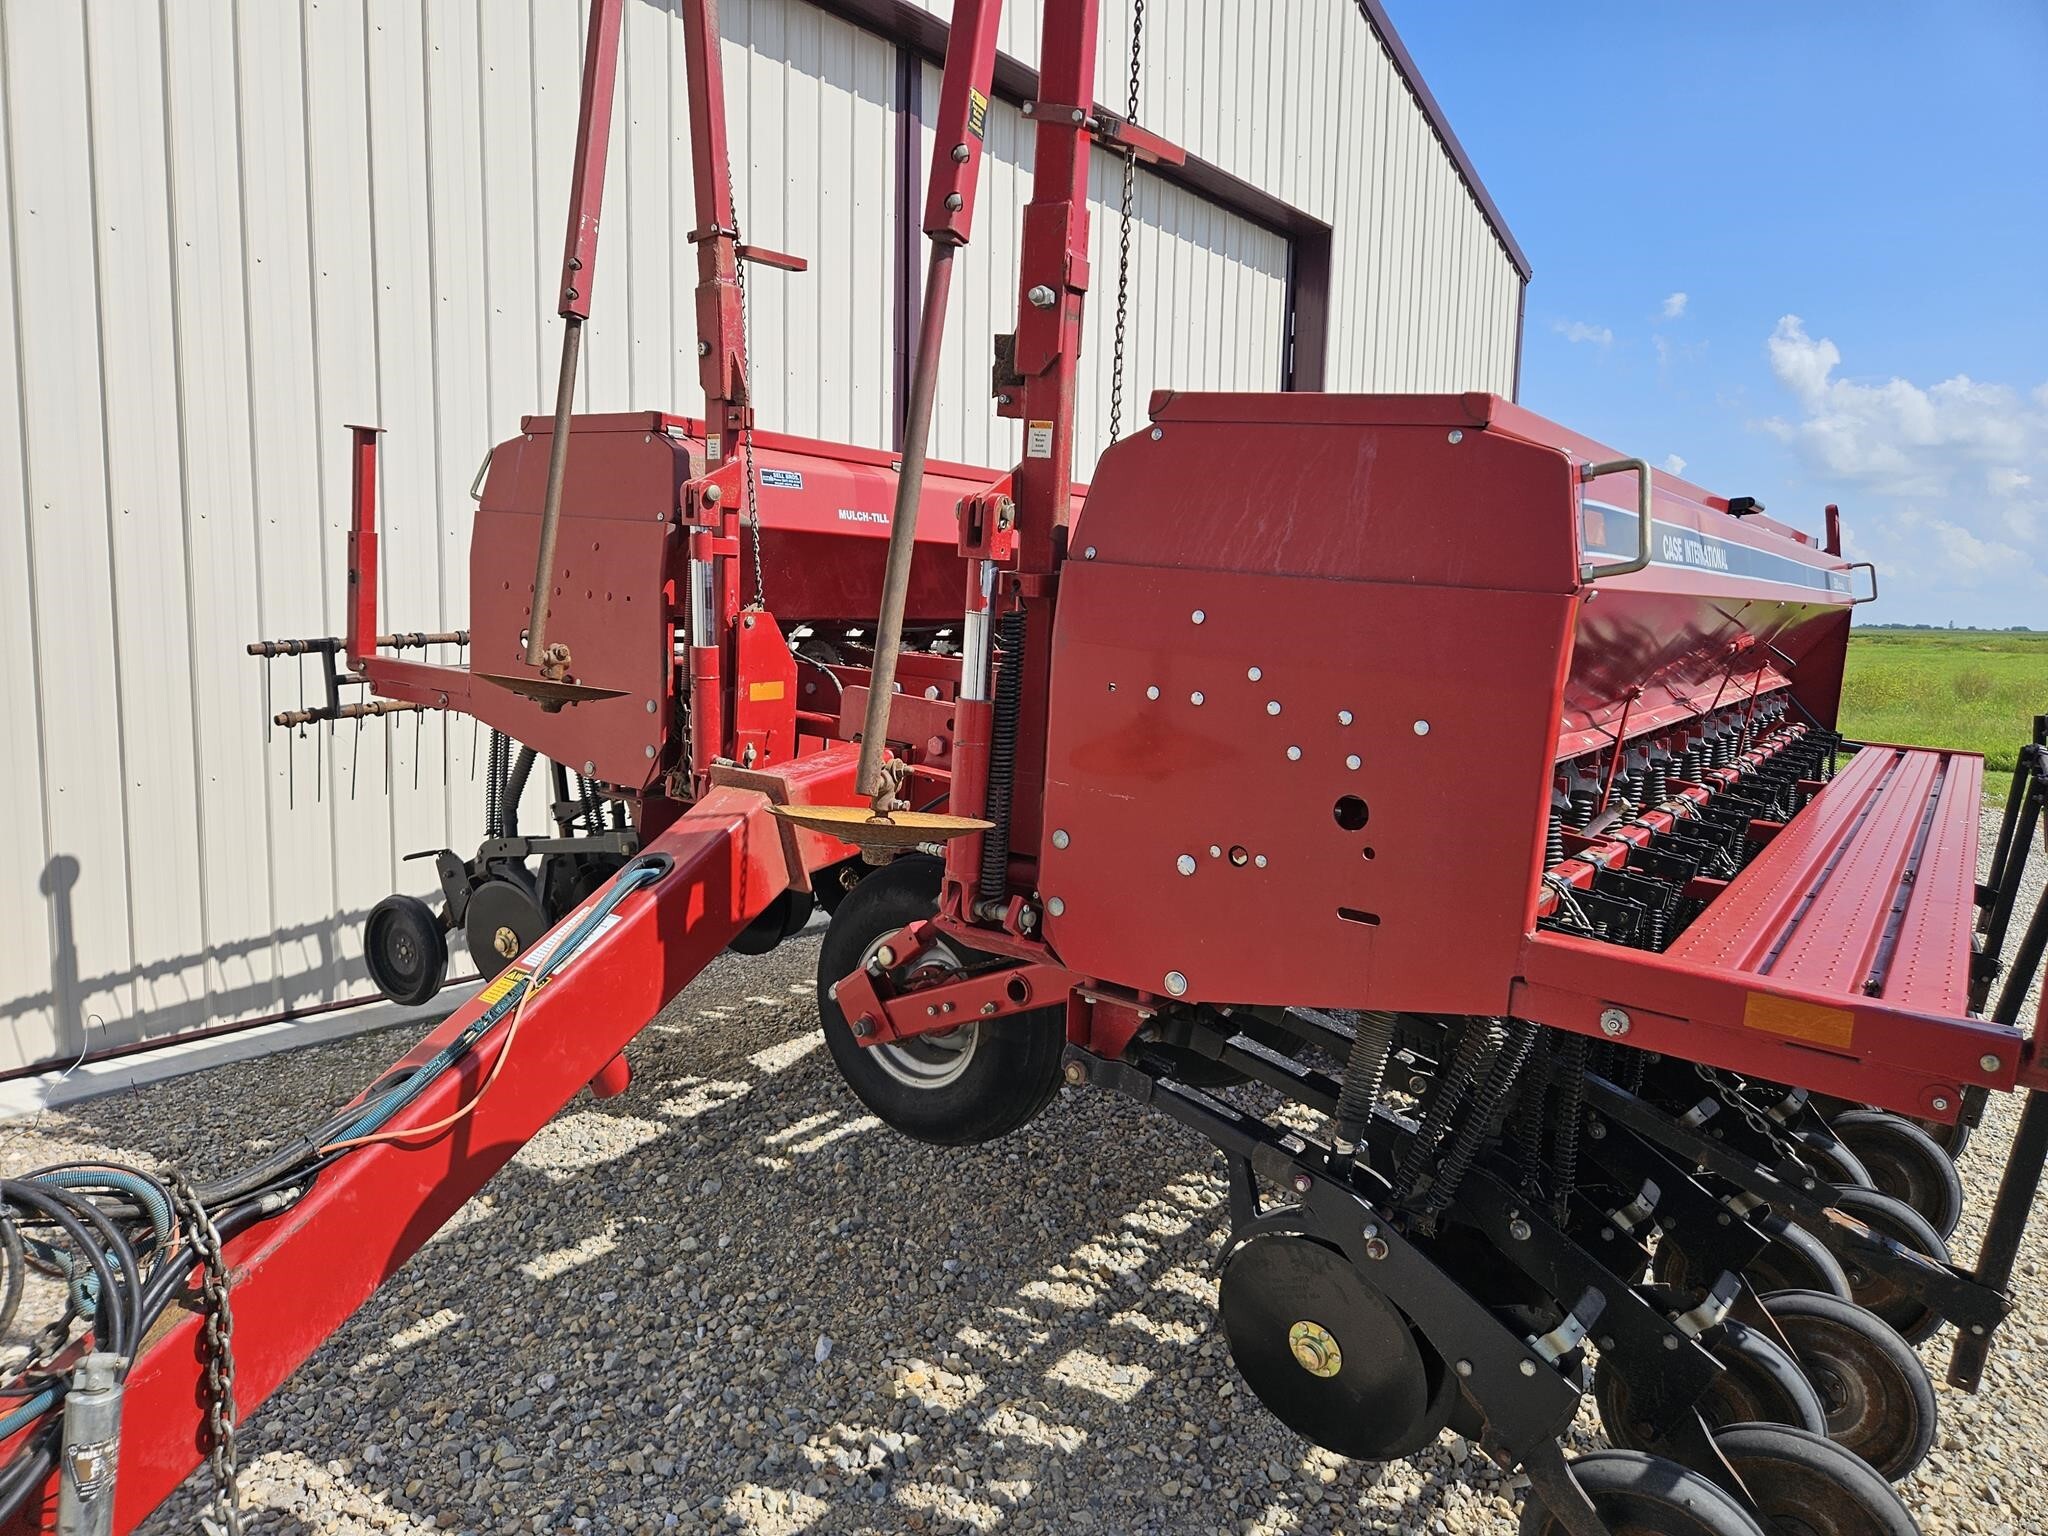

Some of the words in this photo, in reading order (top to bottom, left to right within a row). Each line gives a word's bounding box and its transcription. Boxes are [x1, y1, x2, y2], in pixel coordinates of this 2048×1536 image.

[838, 509, 890, 524] MULCH-TILL
[1662, 534, 1683, 562] CASE
[1684, 539, 1729, 570] INTERNATIONAL
